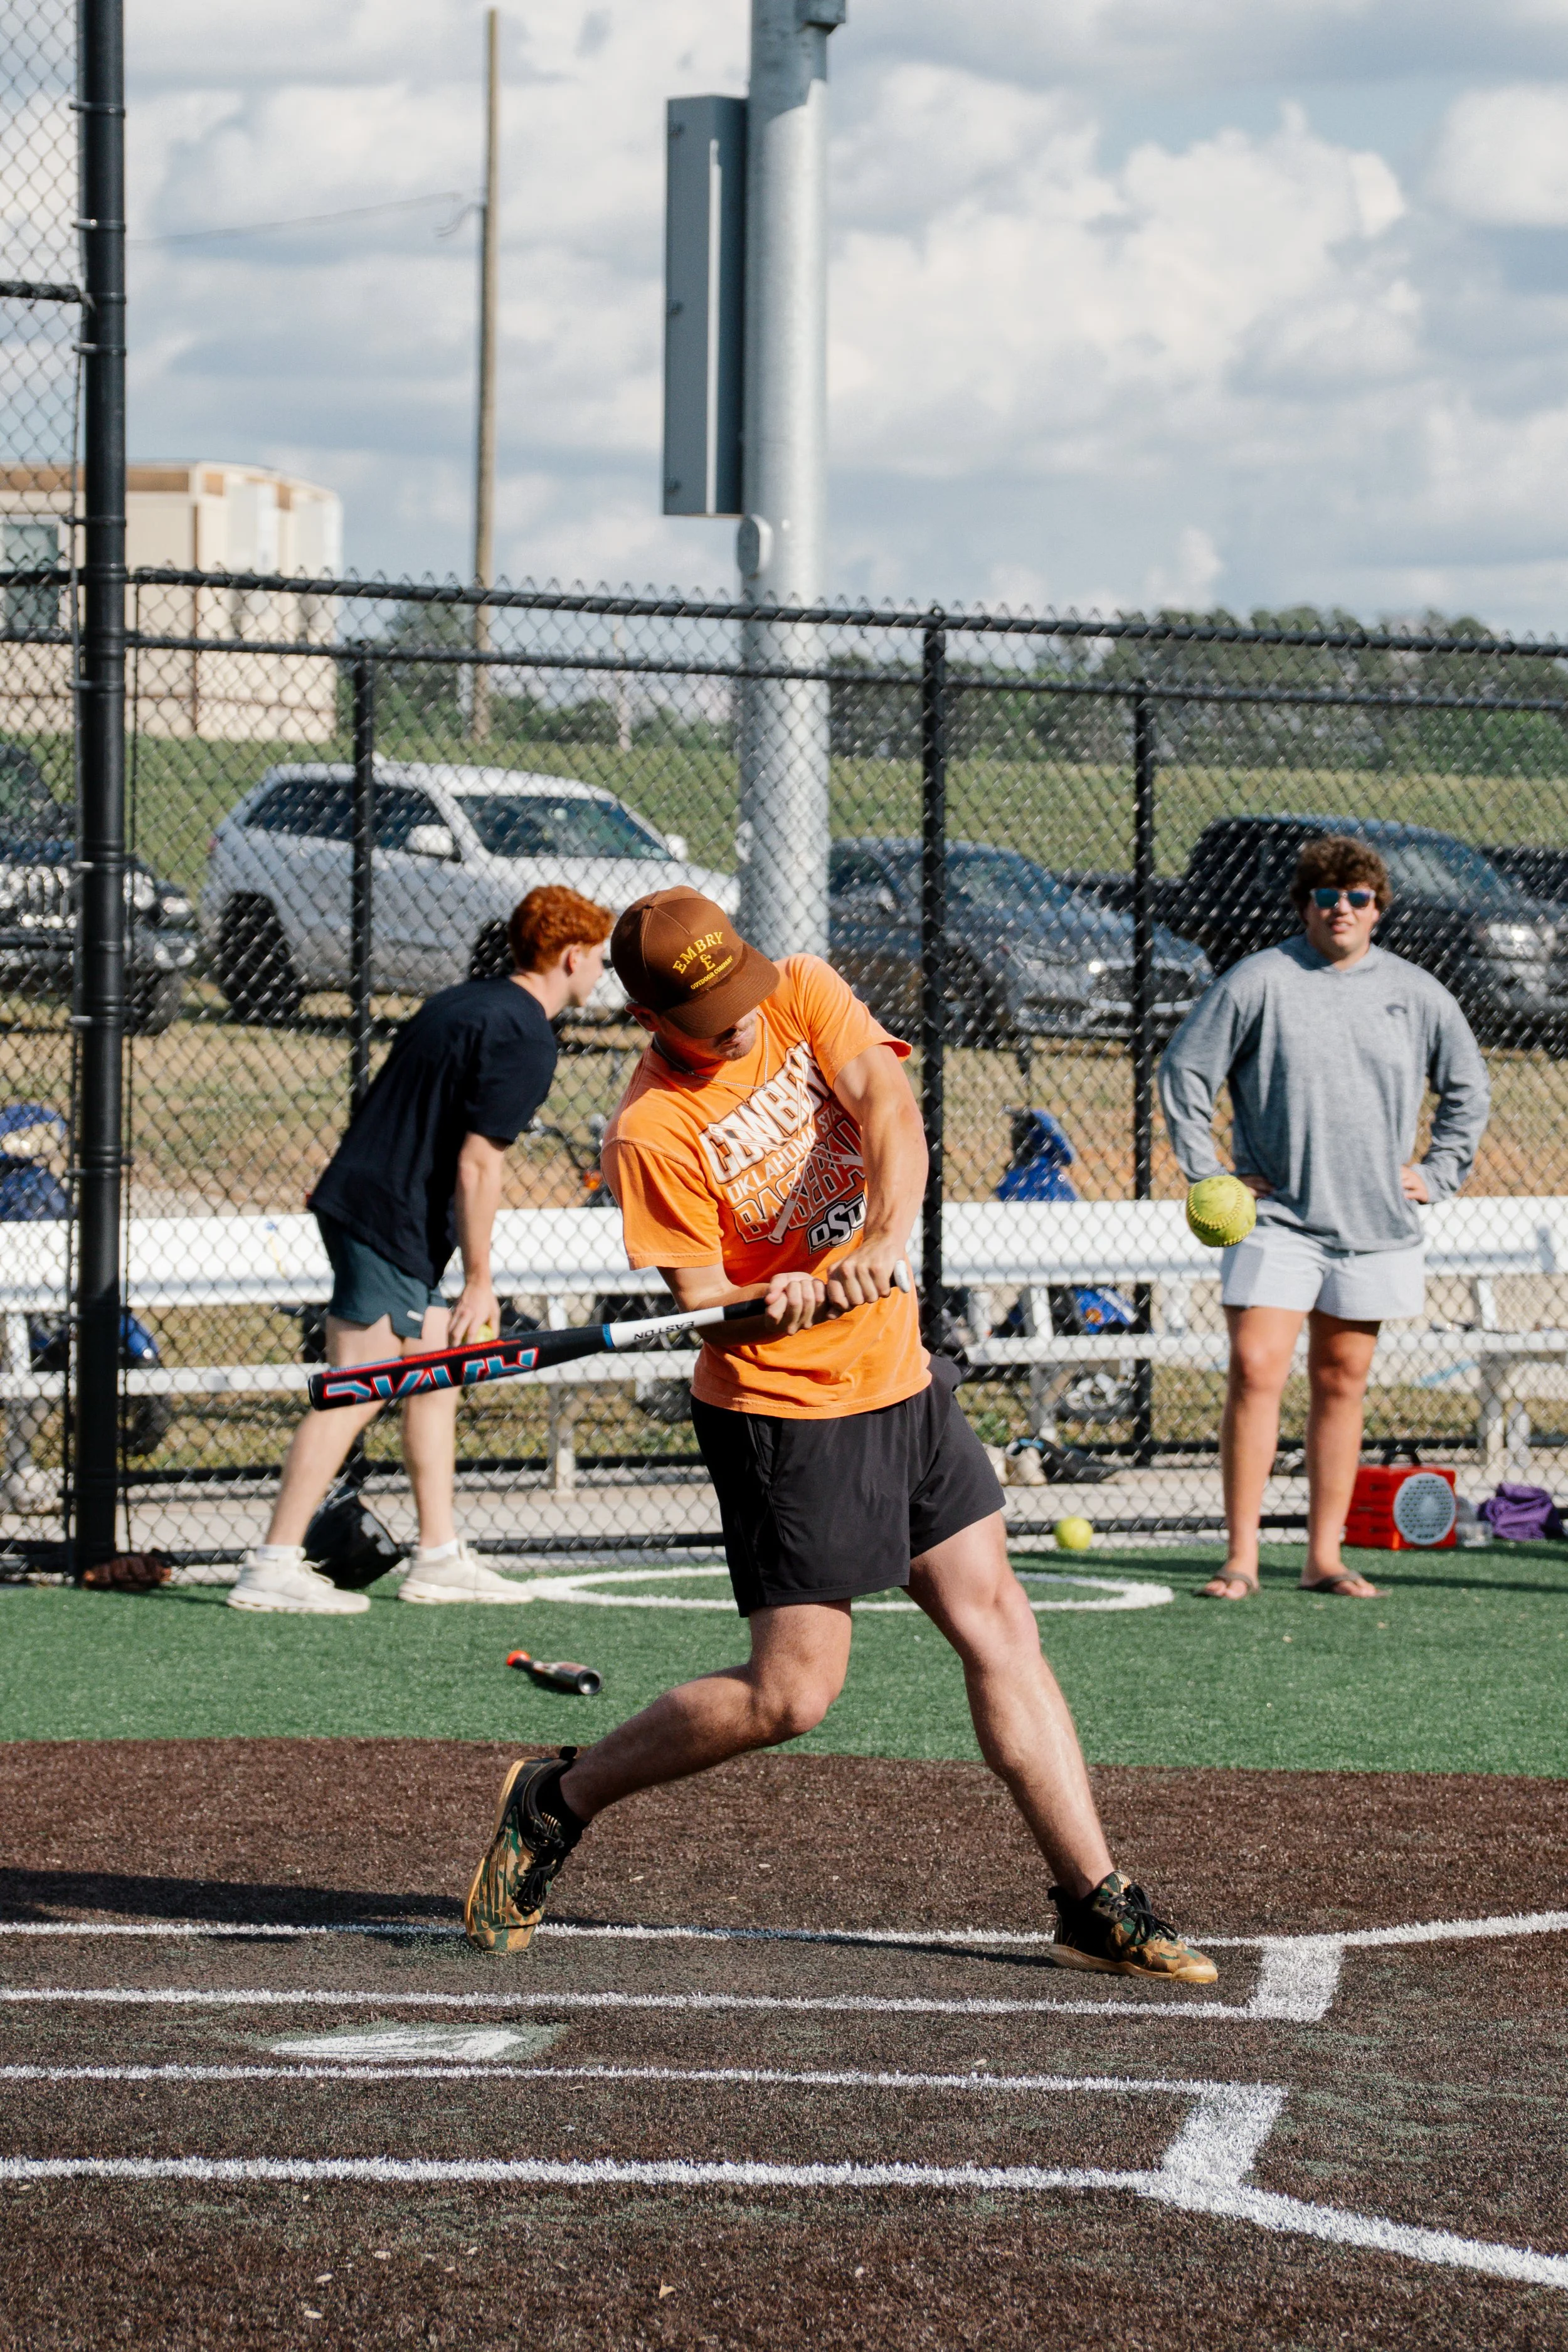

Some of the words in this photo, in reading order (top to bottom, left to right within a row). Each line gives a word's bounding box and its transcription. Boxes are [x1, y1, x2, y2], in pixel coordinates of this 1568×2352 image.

[672, 931, 723, 974] EMBRY
[691, 972, 716, 989] OUTDOOR
[714, 955, 733, 975] COMPANY
[726, 1126, 820, 1203] OKLAHOMA
[809, 1193, 866, 1253] OSU
[633, 1320, 695, 1340] EASTON
